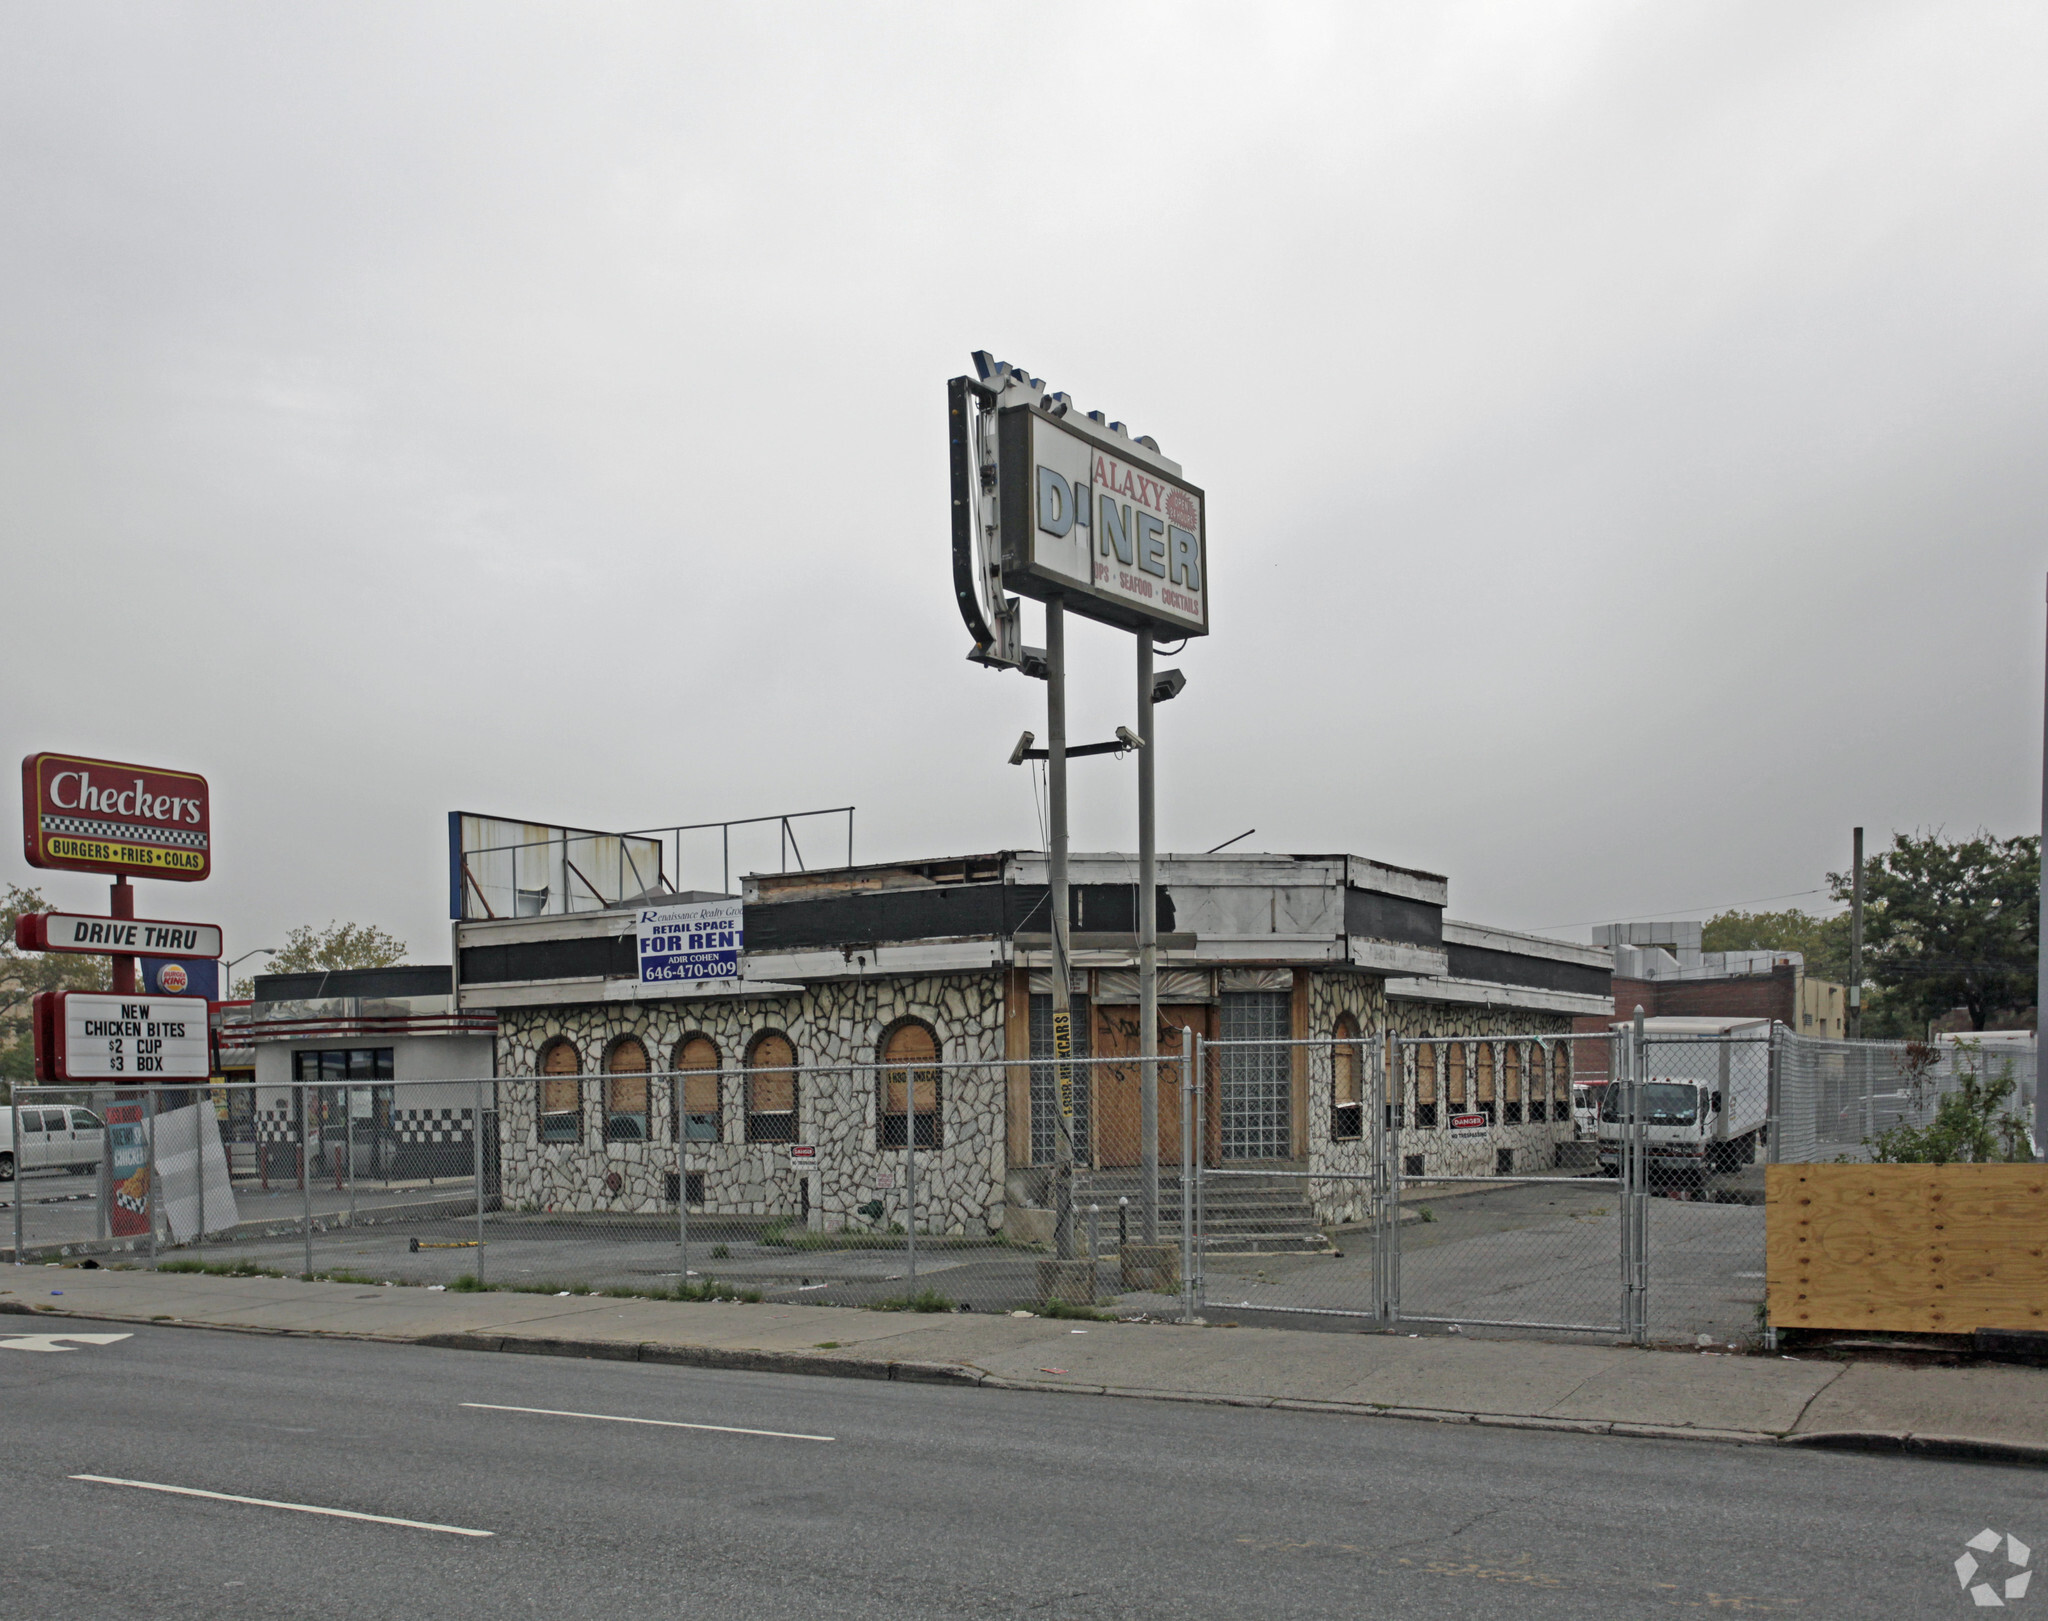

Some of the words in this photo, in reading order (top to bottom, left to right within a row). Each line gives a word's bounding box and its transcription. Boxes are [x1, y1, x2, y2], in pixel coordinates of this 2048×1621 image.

[1093, 456, 1166, 512] ALAXY
[1037, 465, 1200, 591] DINER
[1120, 571, 1153, 599] SEAFOOD
[1162, 587, 1199, 616] COCKTAILS
[50, 771, 201, 824] Checkers
[53, 839, 110, 860] BURGERS
[121, 847, 153, 864] FRIES
[164, 852, 199, 869] COLAS
[640, 910, 699, 923] Renaissance
[700, 908, 724, 920] Realty
[74, 921, 137, 946] DRIVE
[144, 927, 198, 950] THRU
[653, 923, 692, 935] RETAIL
[694, 920, 735, 932] SPACE
[640, 935, 682, 953] FOR
[688, 930, 744, 950] RENT
[668, 955, 688, 964] ADIR
[690, 953, 719, 963] COHEN
[646, 961, 737, 981] 646-470-009
[163, 977, 187, 986] KING
[121, 1004, 150, 1020] NEW
[85, 1020, 141, 1037] CHICKEN
[147, 1021, 185, 1038] BITES
[109, 1039, 123, 1054] $2
[137, 1039, 162, 1055] CUP
[110, 1056, 124, 1071] $3
[137, 1056, 163, 1072] BOX
